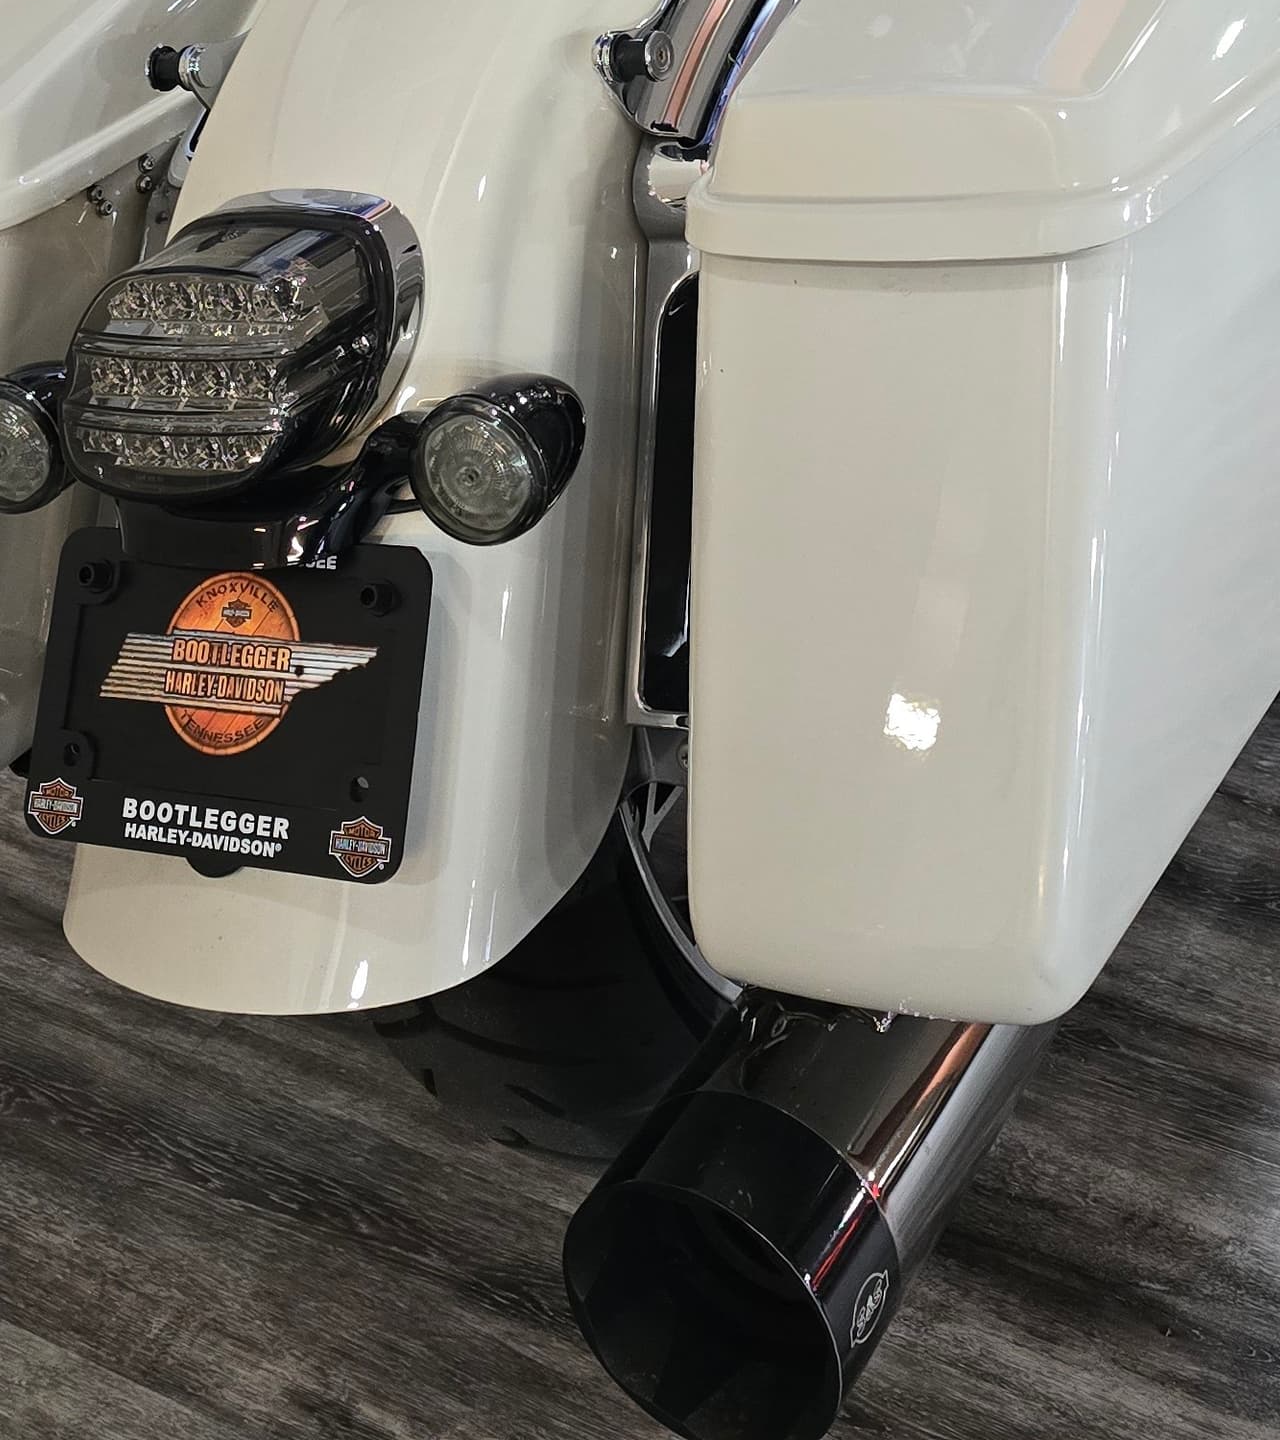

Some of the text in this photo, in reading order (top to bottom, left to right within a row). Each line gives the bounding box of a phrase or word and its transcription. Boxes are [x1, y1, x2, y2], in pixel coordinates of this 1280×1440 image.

[195, 581, 280, 613] KNOXVILLE
[172, 639, 291, 671] BOOTLEGGER
[165, 670, 285, 703] HARLEY-DAVIDSON
[181, 709, 265, 743] TENNESSEE
[122, 797, 290, 840] BOOTLEGGER
[348, 823, 377, 838] MOTOR
[344, 854, 372, 871] CYCLES
